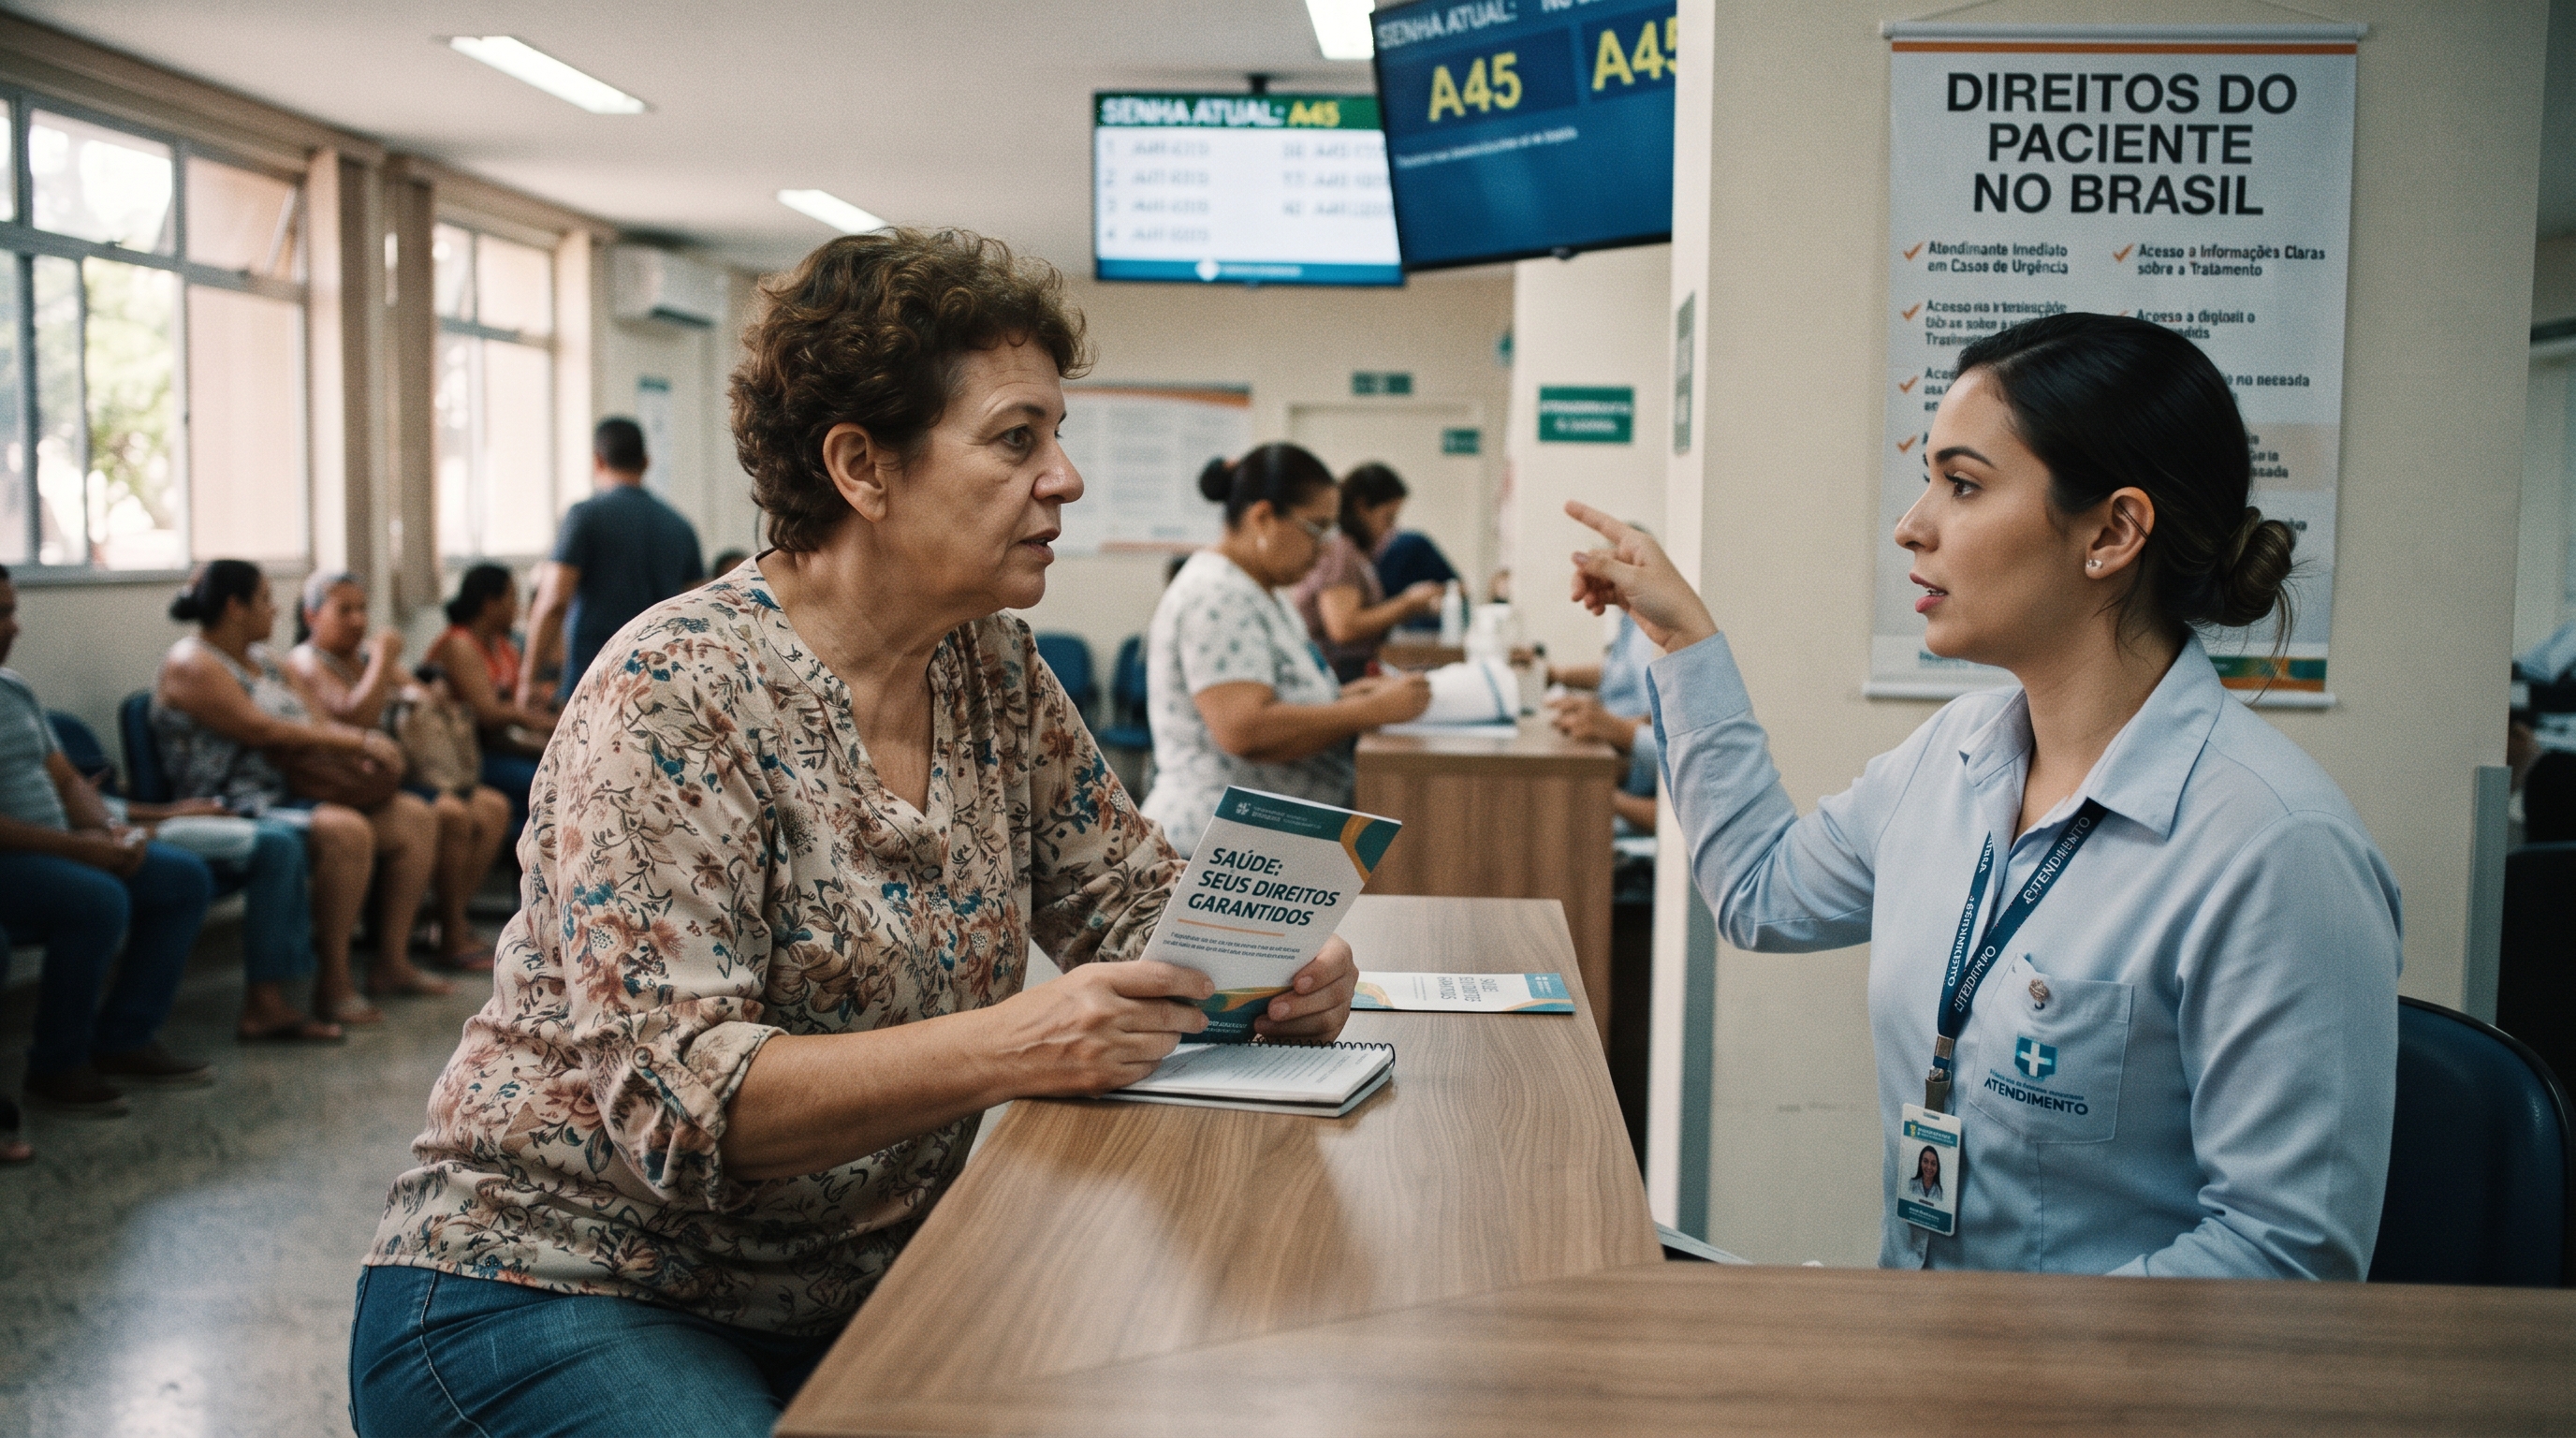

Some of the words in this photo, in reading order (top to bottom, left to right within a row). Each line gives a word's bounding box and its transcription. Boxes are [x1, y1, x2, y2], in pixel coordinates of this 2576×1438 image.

[1376, 9, 1445, 50] SENHA
[1428, 51, 1523, 123] A45
[1947, 72, 2201, 114] DIREITOS
[2219, 73, 2298, 115] DO
[1101, 96, 1192, 125] SENHA
[1288, 100, 1341, 128] A45
[1988, 123, 2254, 164] PACIENTE
[1973, 173, 2052, 214] NO
[2070, 173, 2264, 216] BRASIL
[1951, 258, 1990, 273] Casos
[1992, 259, 2009, 273] de
[2138, 243, 2185, 258] Acesso
[2284, 244, 2326, 260] Claras
[2190, 262, 2263, 276] Tratamento
[1209, 847, 1283, 876] SAÚDE:
[1198, 870, 1252, 894] SEUS
[1251, 880, 1341, 907] DIREITOS
[1188, 893, 1315, 926] GARANTIDOS
[1983, 1077, 2089, 1116] ATENDIMENTO
